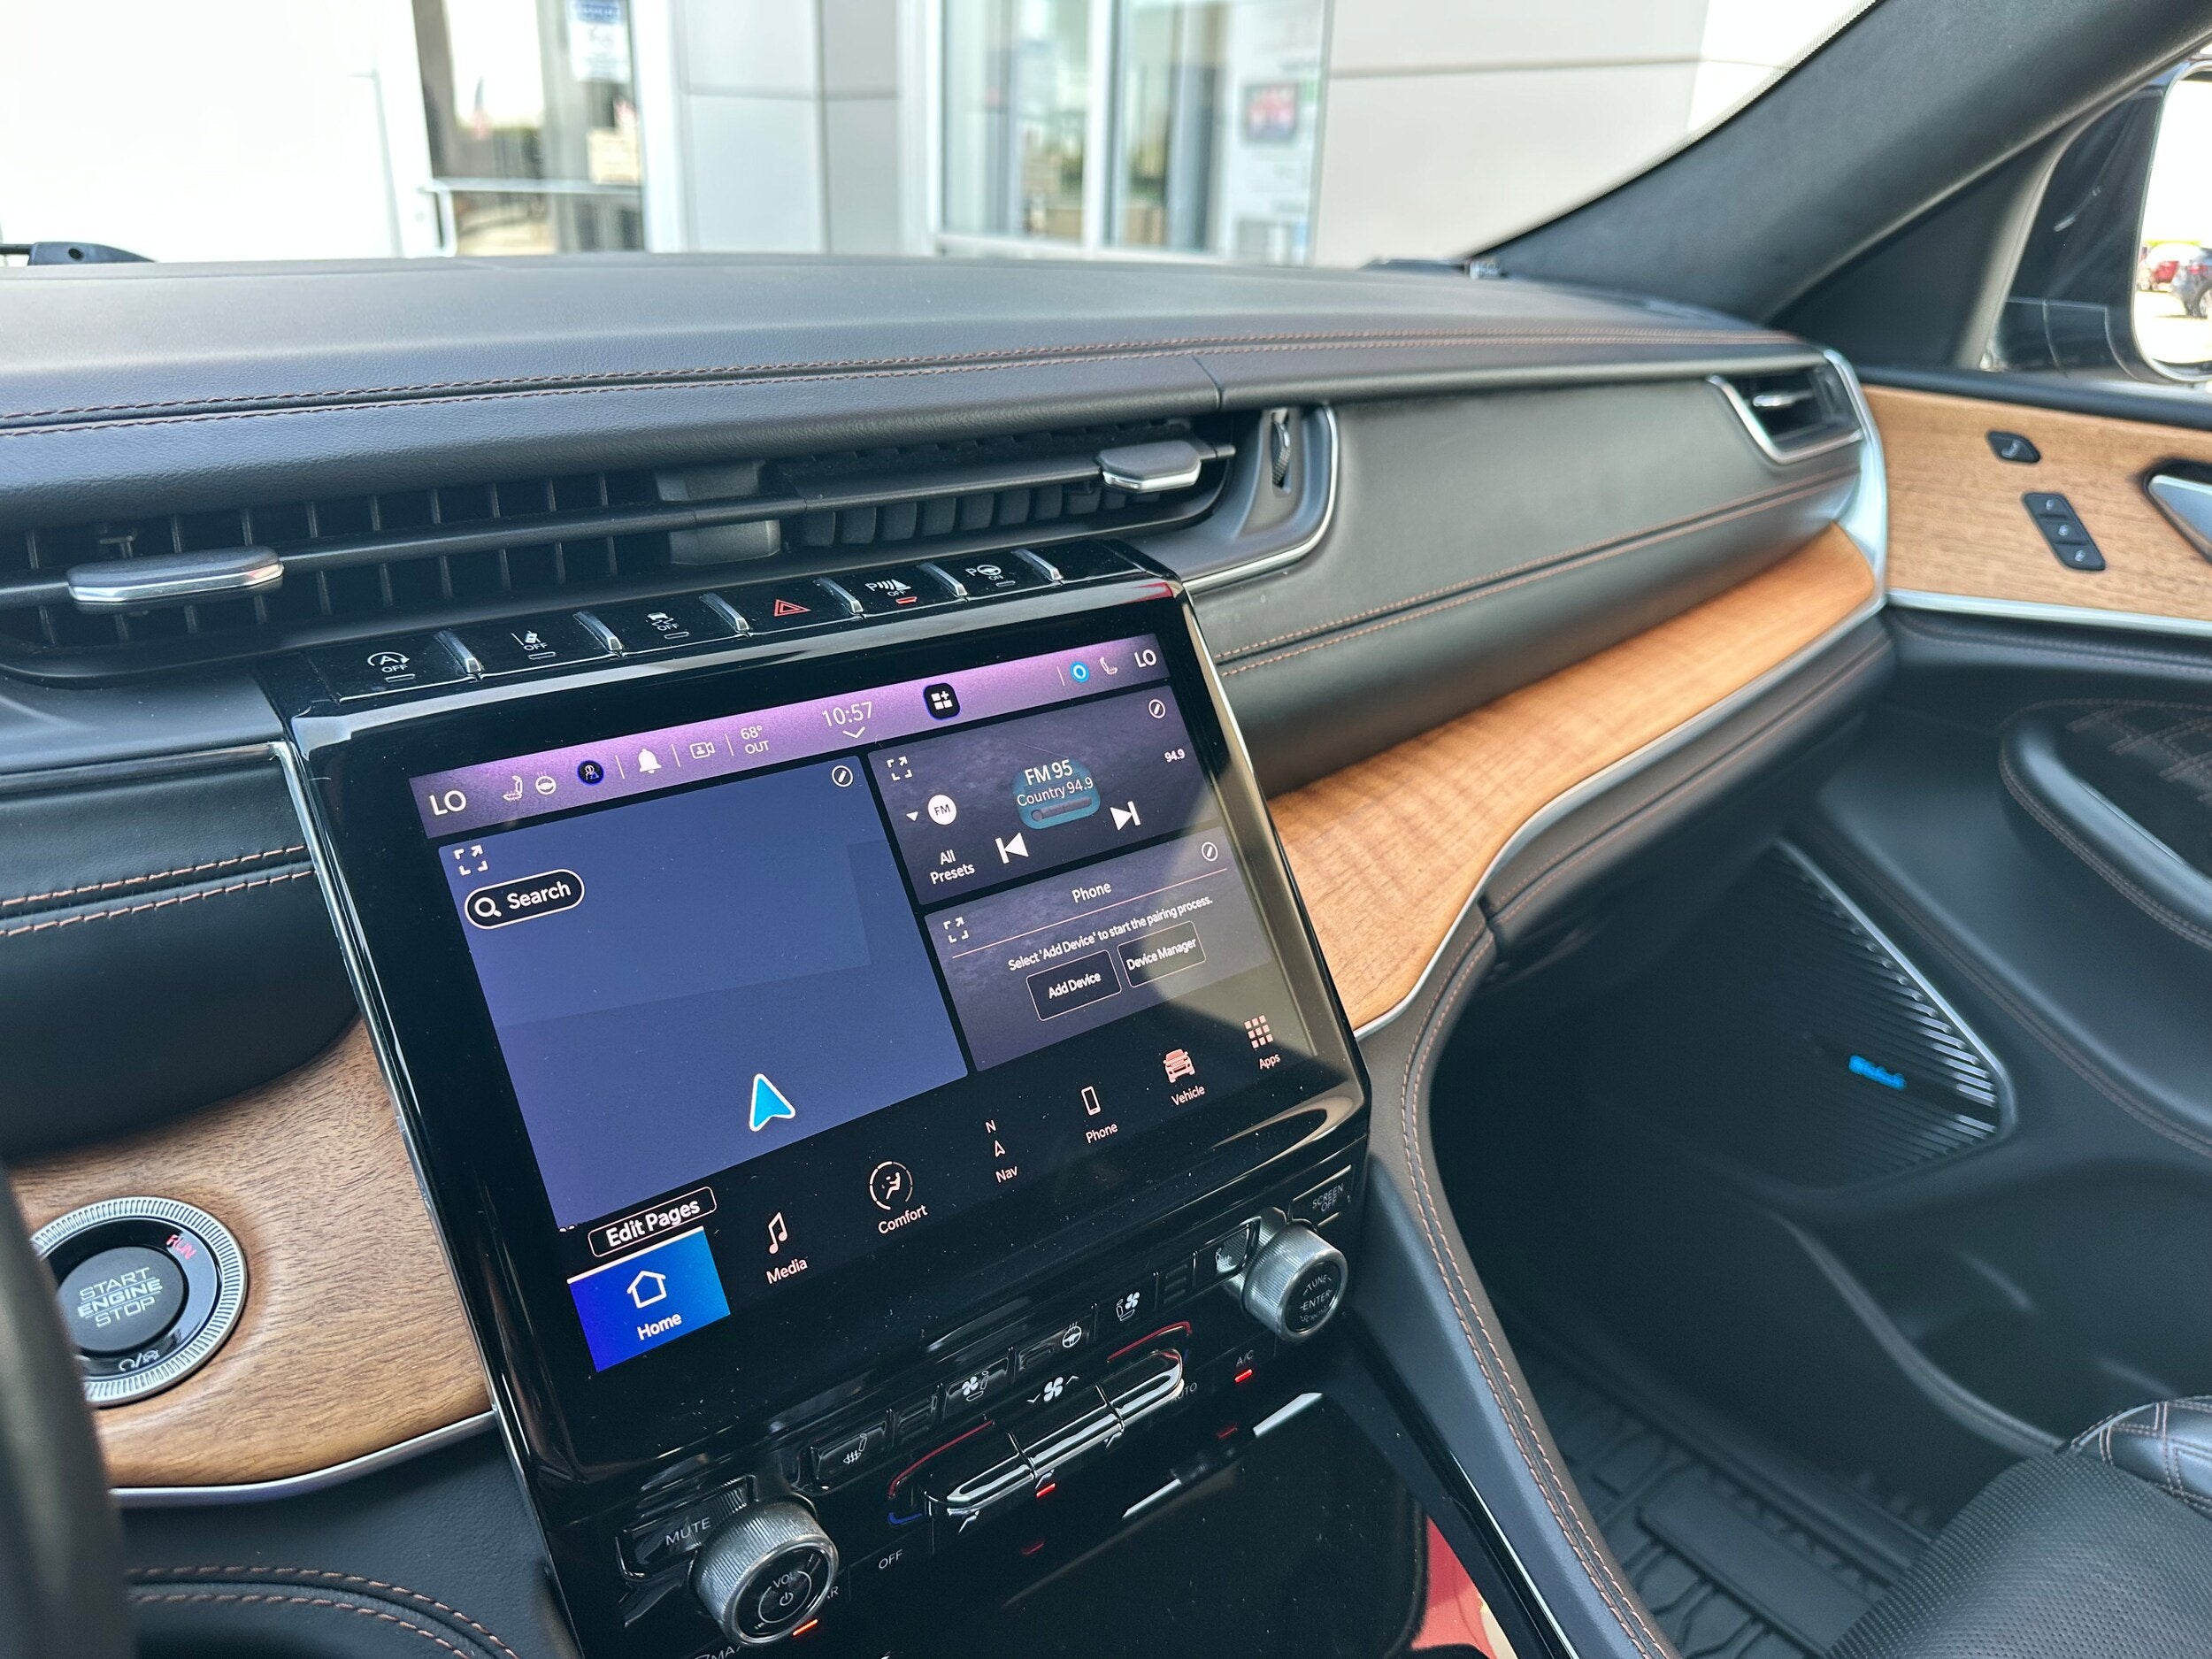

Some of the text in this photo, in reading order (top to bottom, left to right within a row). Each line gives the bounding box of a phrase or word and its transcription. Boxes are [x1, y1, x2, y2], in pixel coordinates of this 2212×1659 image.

[657, 622, 680, 632] OFF
[523, 641, 548, 651] OFF
[381, 663, 408, 673] OFF
[1134, 649, 1157, 669] LO
[822, 701, 874, 727] 10:57
[741, 726, 763, 741] 68°
[744, 741, 769, 755] OUT
[1164, 749, 1186, 763] 94.9
[1025, 759, 1073, 786] FM 95
[429, 790, 467, 816] LO
[1017, 777, 1094, 808] Country 94.9
[934, 803, 951, 815] FM
[940, 849, 956, 864] All
[930, 863, 975, 885] Presets
[507, 880, 572, 910] Search
[1071, 880, 1112, 903] Phone
[1008, 953, 1039, 972] Select
[1097, 928, 1109, 941] to
[1109, 921, 1131, 938] start
[1131, 916, 1148, 933] the
[1147, 907, 1178, 926] pairing
[1177, 895, 1213, 917] process.
[1126, 936, 1197, 971] Device Manager
[1048, 971, 1102, 999] Add Device
[1258, 1053, 1281, 1071] Apps
[1171, 1084, 1205, 1106] Vehicle
[1086, 1122, 1118, 1144] Phone
[995, 1166, 1018, 1184] Nav
[1312, 1183, 1344, 1209] SCREEN
[1321, 1196, 1337, 1212] OFF
[606, 1199, 701, 1248] Edit Pages
[878, 1204, 928, 1235] Comfort
[166, 1234, 196, 1260] RUN
[766, 1258, 808, 1285] Media
[1306, 1274, 1327, 1290] TUNE
[80, 1267, 150, 1301] START
[78, 1279, 163, 1317] ENGINE
[1302, 1289, 1332, 1310] ENTER
[95, 1295, 155, 1328] STOP
[636, 1312, 682, 1340] Home
[1236, 1350, 1253, 1367] A/C
[665, 1517, 711, 1546] MUTE
[879, 1549, 902, 1570] OFF
[773, 1571, 795, 1588] VOL
